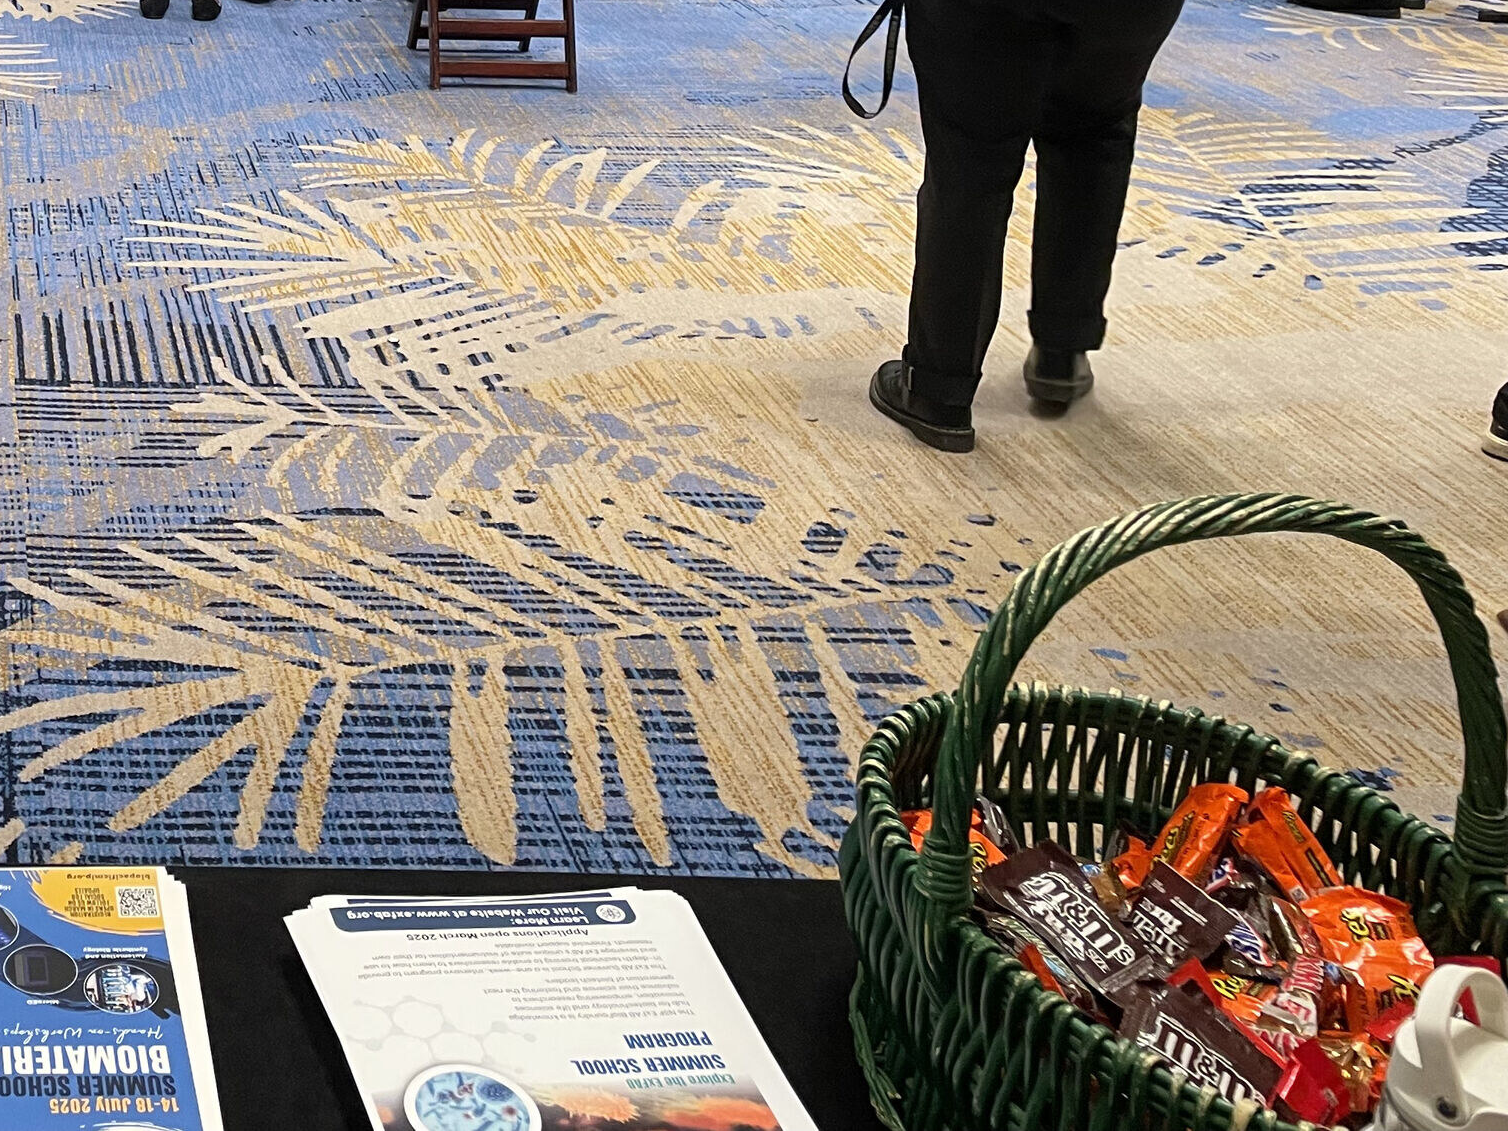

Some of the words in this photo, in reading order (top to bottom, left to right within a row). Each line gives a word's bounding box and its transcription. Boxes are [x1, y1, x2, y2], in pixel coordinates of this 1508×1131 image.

[346, 909, 450, 920] www.exfab.org
[452, 910, 467, 918] at
[469, 908, 526, 918] Website
[526, 907, 550, 916] Our
[551, 906, 584, 916] Visit
[510, 916, 549, 926] More:
[549, 915, 590, 925] Learn
[406, 933, 437, 941] 2025
[480, 930, 510, 938] open
[512, 928, 589, 937] Applications
[87, 1026, 163, 1044] Hands-on
[622, 1031, 713, 1049] PROGRAM
[570, 1058, 641, 1075] SCHOOL
[642, 1054, 726, 1072] SUMMER
[626, 1077, 663, 1090] ExFAB
[664, 1076, 687, 1087] the
[687, 1073, 735, 1085] Explore
[76, 1075, 176, 1097] SUMMER
[49, 1098, 90, 1114] 2025
[95, 1096, 131, 1113] July
[136, 1097, 179, 1112] 14-18
